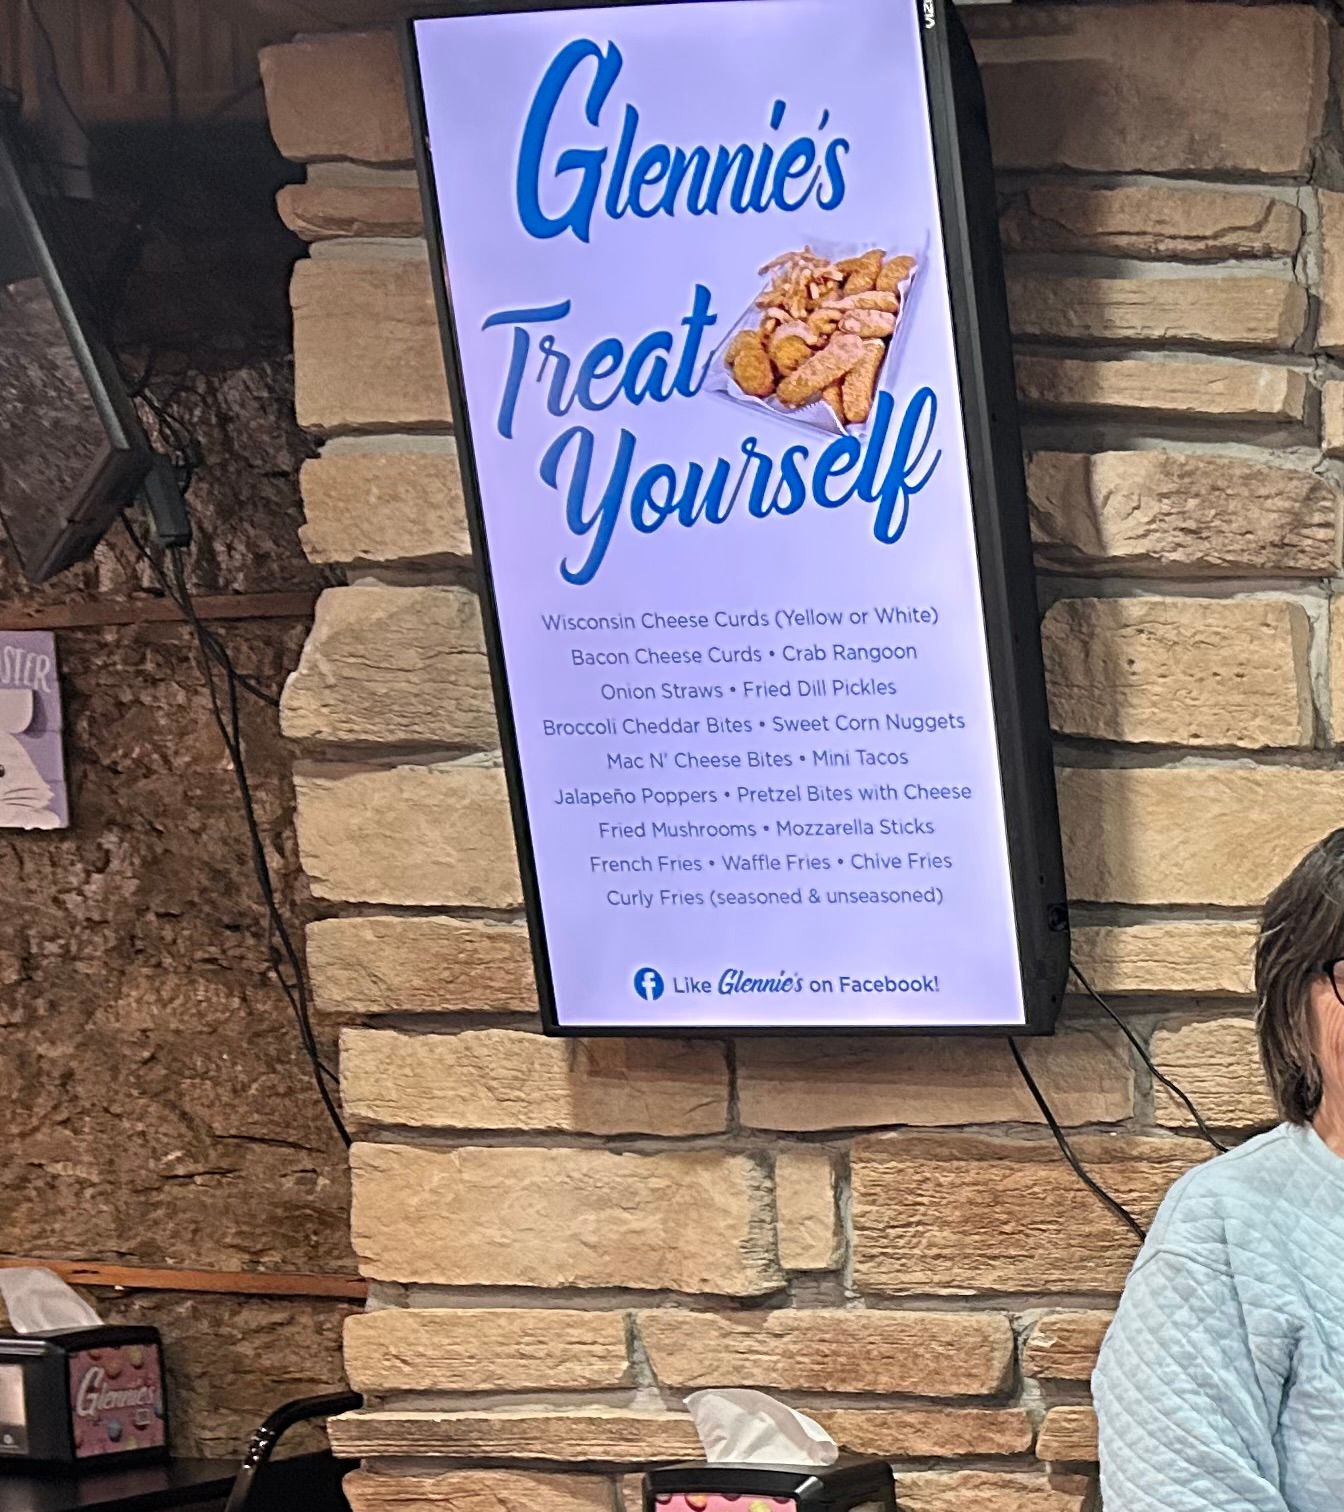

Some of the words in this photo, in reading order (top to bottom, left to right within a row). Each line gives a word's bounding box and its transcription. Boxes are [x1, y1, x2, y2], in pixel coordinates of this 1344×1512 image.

[516, 38, 850, 243] Glennie's
[481, 284, 716, 439] Treat
[540, 387, 942, 586] Yourself
[541, 613, 636, 631] Wisconsin
[641, 612, 709, 629] Cheese
[714, 609, 770, 627] Curds
[775, 608, 843, 630] (Yellow
[848, 611, 869, 625] or
[873, 606, 938, 626] White)
[571, 649, 630, 665] Bacon
[634, 648, 702, 664] Cheese
[707, 645, 762, 664] Curds
[782, 643, 827, 663] Crab
[832, 643, 917, 663] Rangoon
[1, 646, 51, 692] STER
[601, 682, 656, 700] Onion
[661, 683, 723, 699] Straws
[743, 680, 792, 698] Fried
[797, 679, 826, 697] Dill
[832, 677, 897, 696] Pickles
[543, 717, 618, 736] Broccoli
[622, 717, 700, 736] Cheddar
[706, 717, 752, 735] Bites
[772, 715, 830, 732] Sweet
[834, 714, 880, 731] Corn
[886, 713, 965, 733] Nuggets
[607, 752, 645, 770] Mac
[650, 752, 668, 768] N'
[674, 752, 742, 768] Cheese
[747, 751, 793, 768] Bites
[812, 749, 851, 767] Mini
[854, 749, 909, 766] Tacos
[554, 788, 637, 808] Jalapeño
[641, 788, 718, 808] Poppers
[737, 785, 802, 803] Pretzel
[807, 785, 853, 801] Bites
[858, 784, 898, 801] with
[904, 784, 972, 800] Cheese
[599, 821, 646, 839] Fried
[652, 820, 757, 839] Mushrooms
[776, 818, 874, 837] Mozzarella
[880, 817, 936, 835] Sticks
[590, 856, 653, 872] French
[658, 856, 703, 872] Fries
[721, 853, 782, 871] Waffle
[786, 854, 832, 872] Fries
[851, 852, 902, 870] Chive
[907, 852, 952, 869] Fries
[607, 888, 654, 908] Curly
[660, 890, 704, 905] Fries
[710, 888, 802, 908] (seasoned
[808, 888, 821, 904] &
[826, 886, 943, 905] unseasoned)
[673, 976, 712, 994] Like
[717, 968, 804, 996] Glennie's
[808, 980, 834, 994] on
[839, 975, 940, 994] Facebook!
